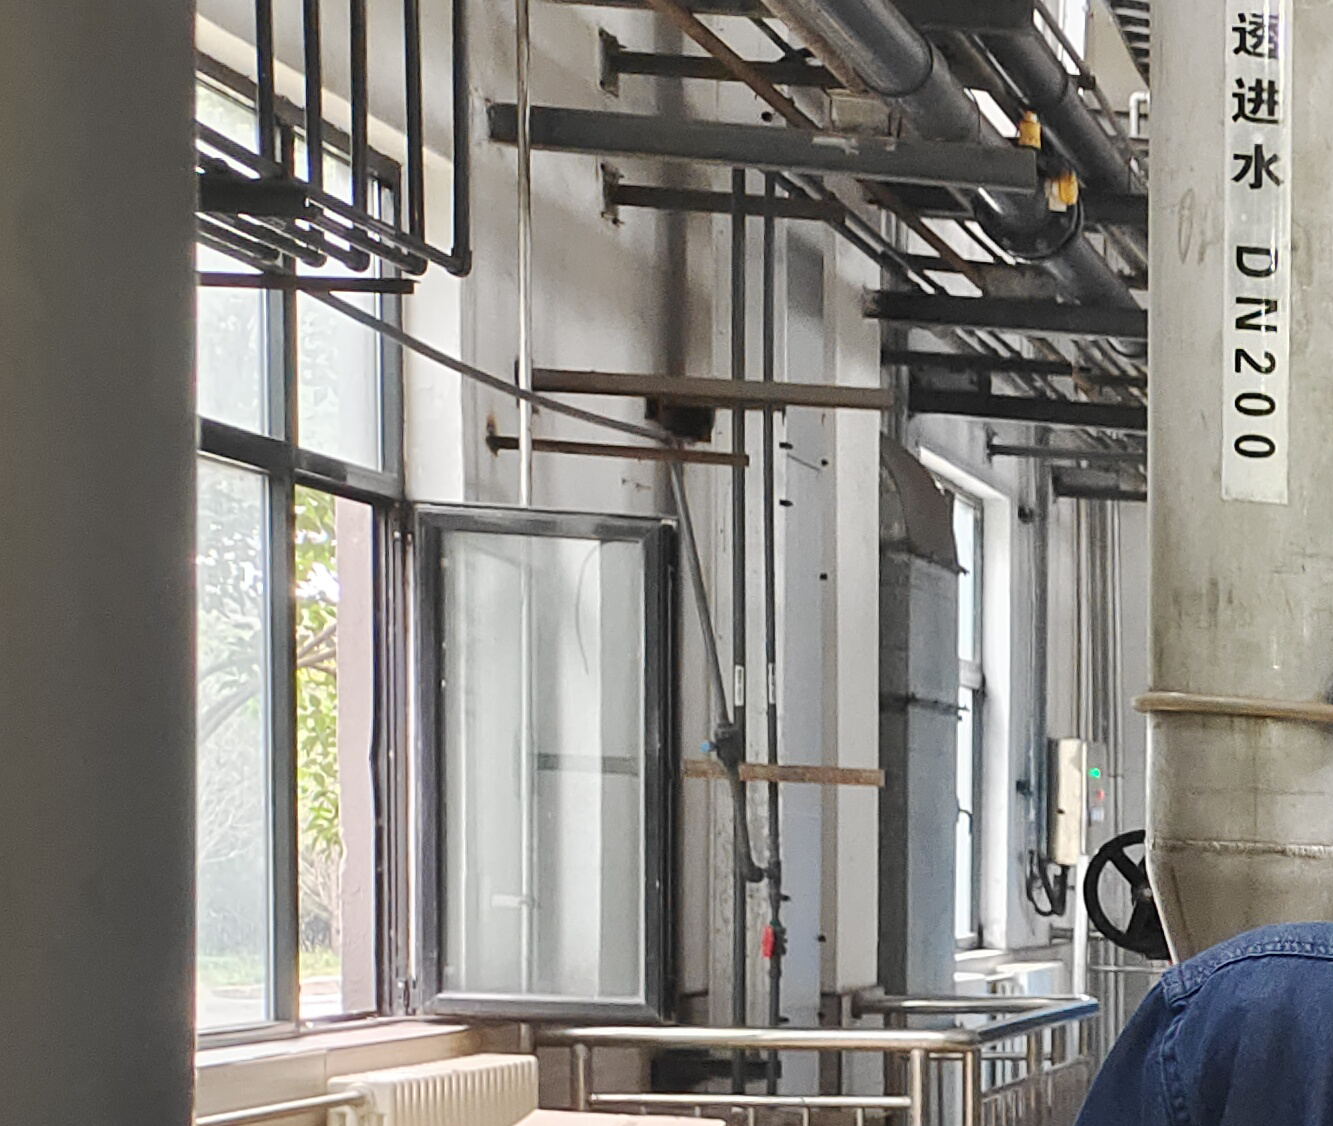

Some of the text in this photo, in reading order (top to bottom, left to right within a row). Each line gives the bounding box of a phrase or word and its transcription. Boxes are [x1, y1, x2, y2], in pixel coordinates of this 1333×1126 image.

[1231, 12, 1283, 460] 透进水 DN200
